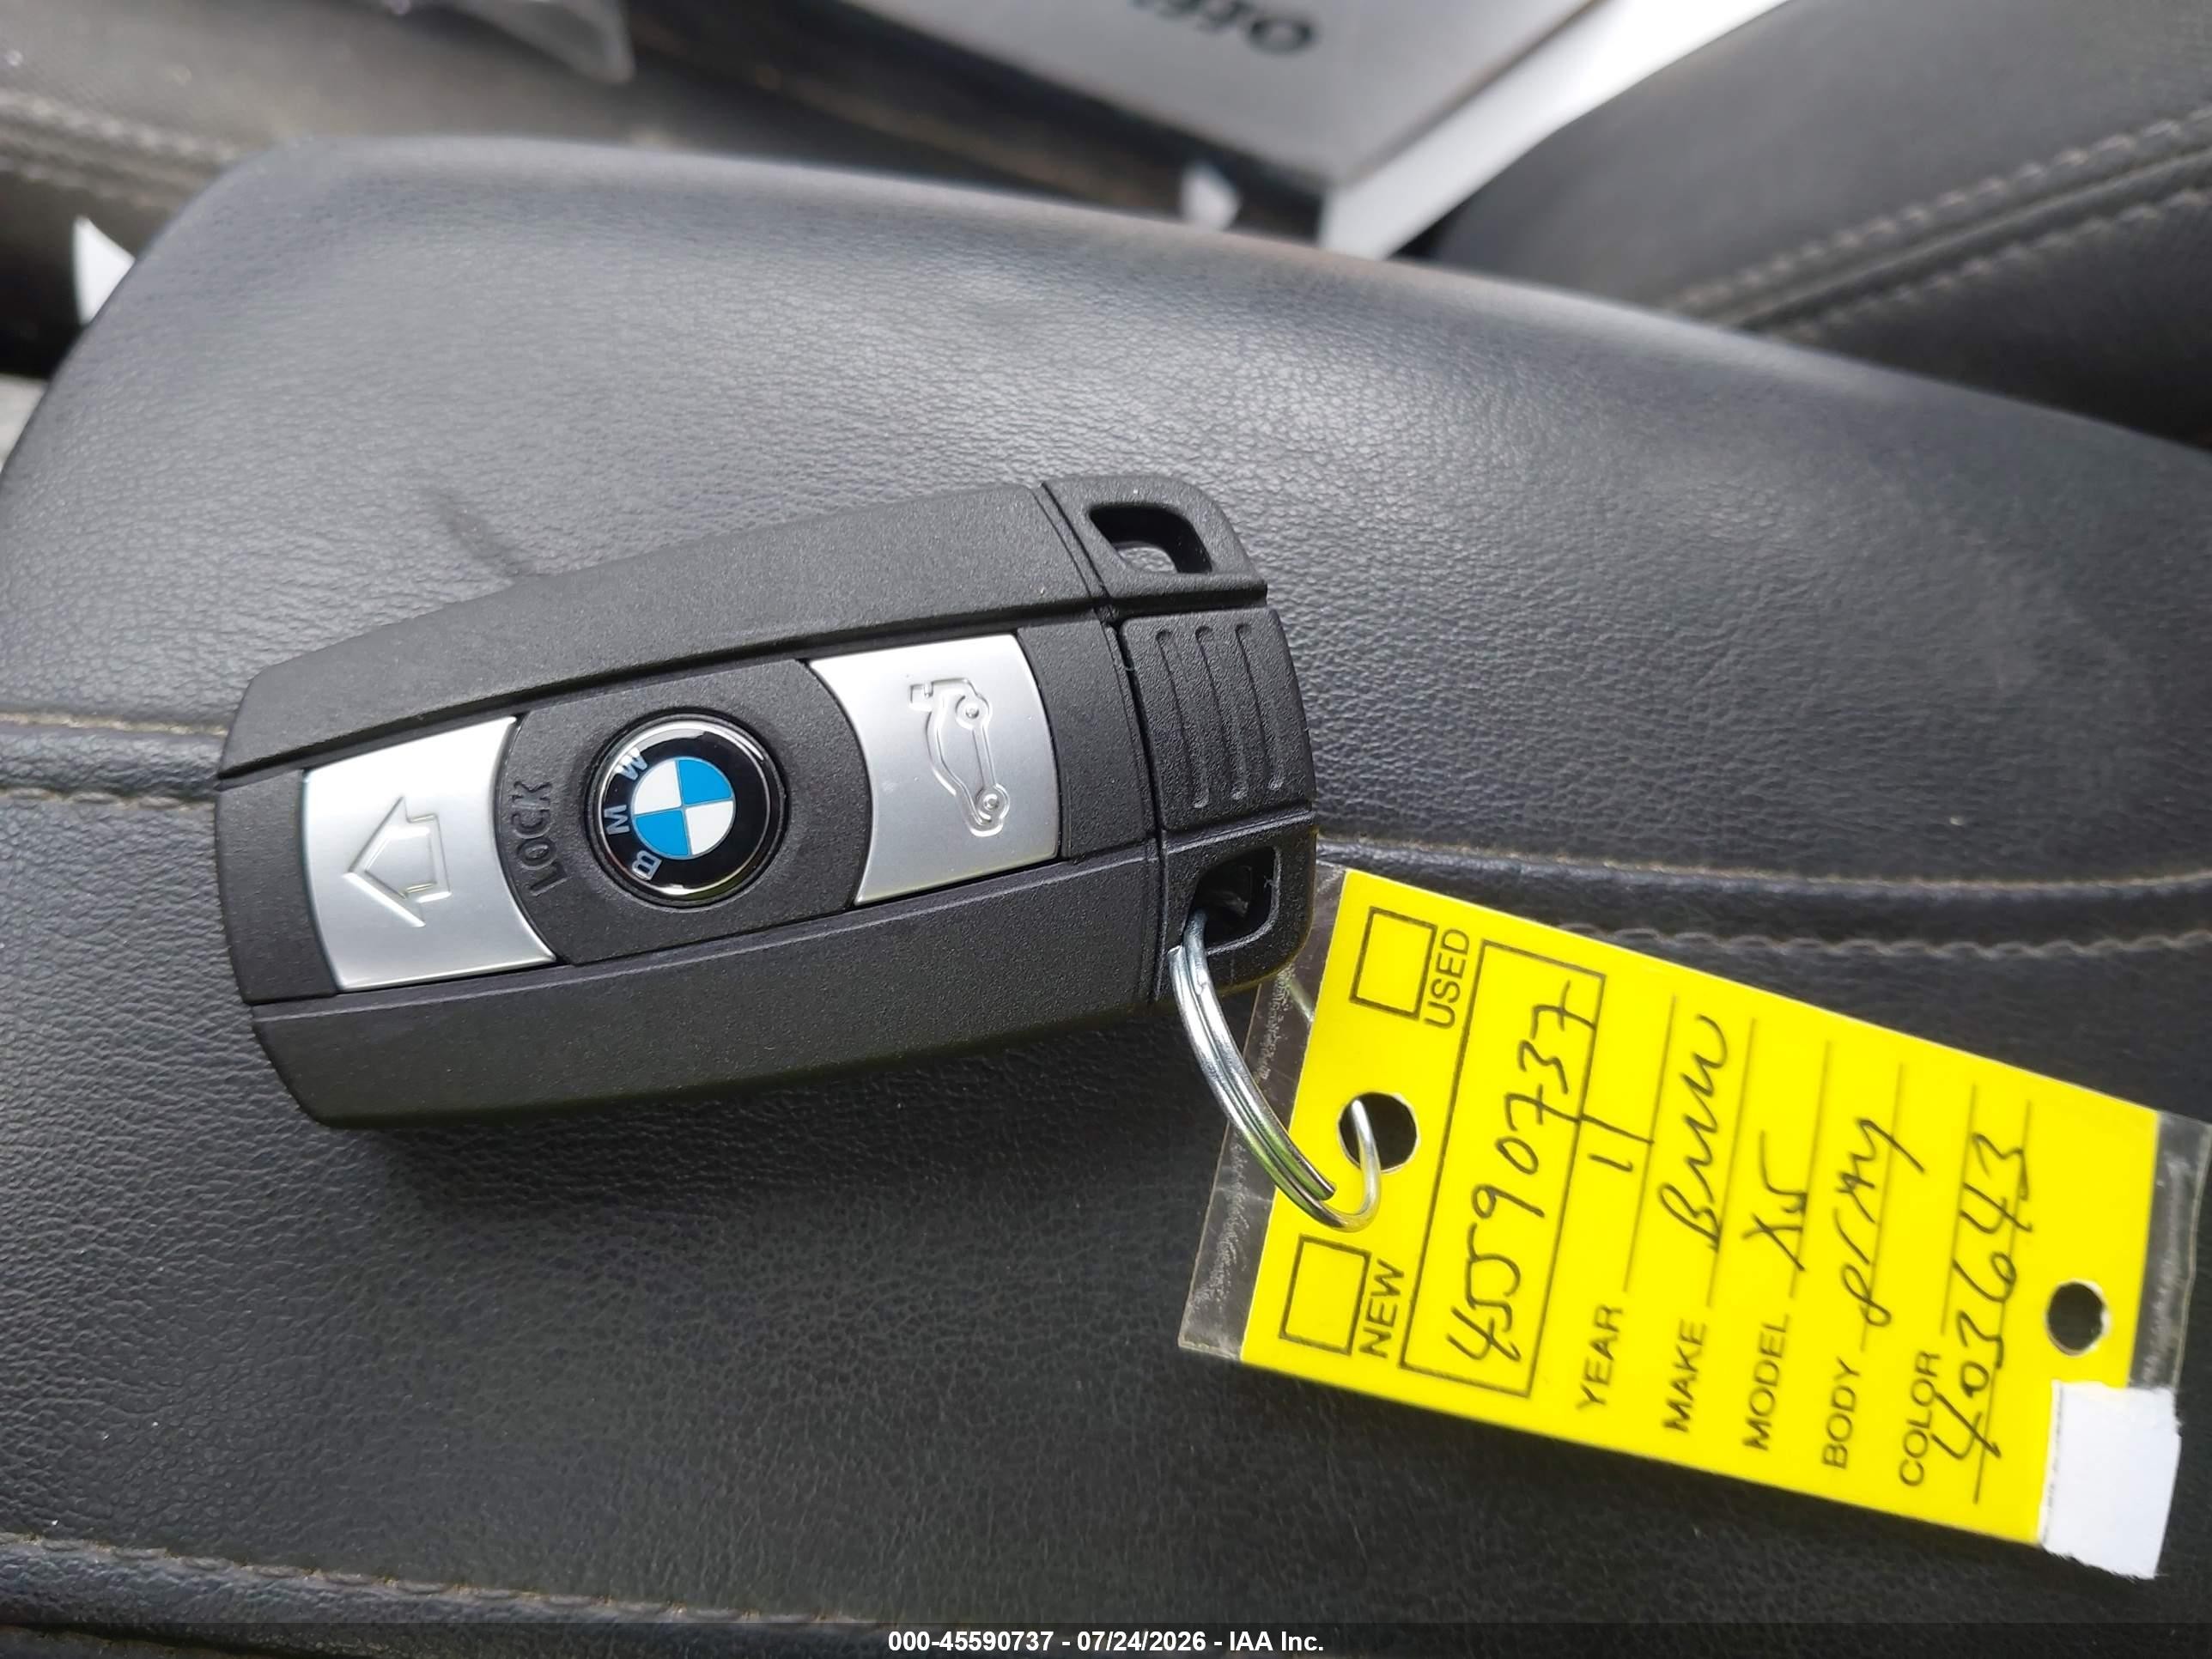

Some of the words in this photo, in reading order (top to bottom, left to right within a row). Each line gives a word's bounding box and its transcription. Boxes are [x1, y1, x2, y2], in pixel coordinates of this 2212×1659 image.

[510, 780, 571, 898] LOCK
[604, 746, 663, 882] BMW
[1424, 927, 1469, 1030] USED
[1446, 980, 1597, 1363] 45590737
[1741, 1130, 1807, 1272] X5
[1359, 1258, 1404, 1358] NEW
[1577, 1303, 1624, 1411] YEAR
[1662, 1319, 1707, 1434] MAKE
[1741, 1313, 1791, 1451] MODEL
[1821, 1358, 1863, 1470] BODY
[1899, 1350, 1942, 1488] COLOR
